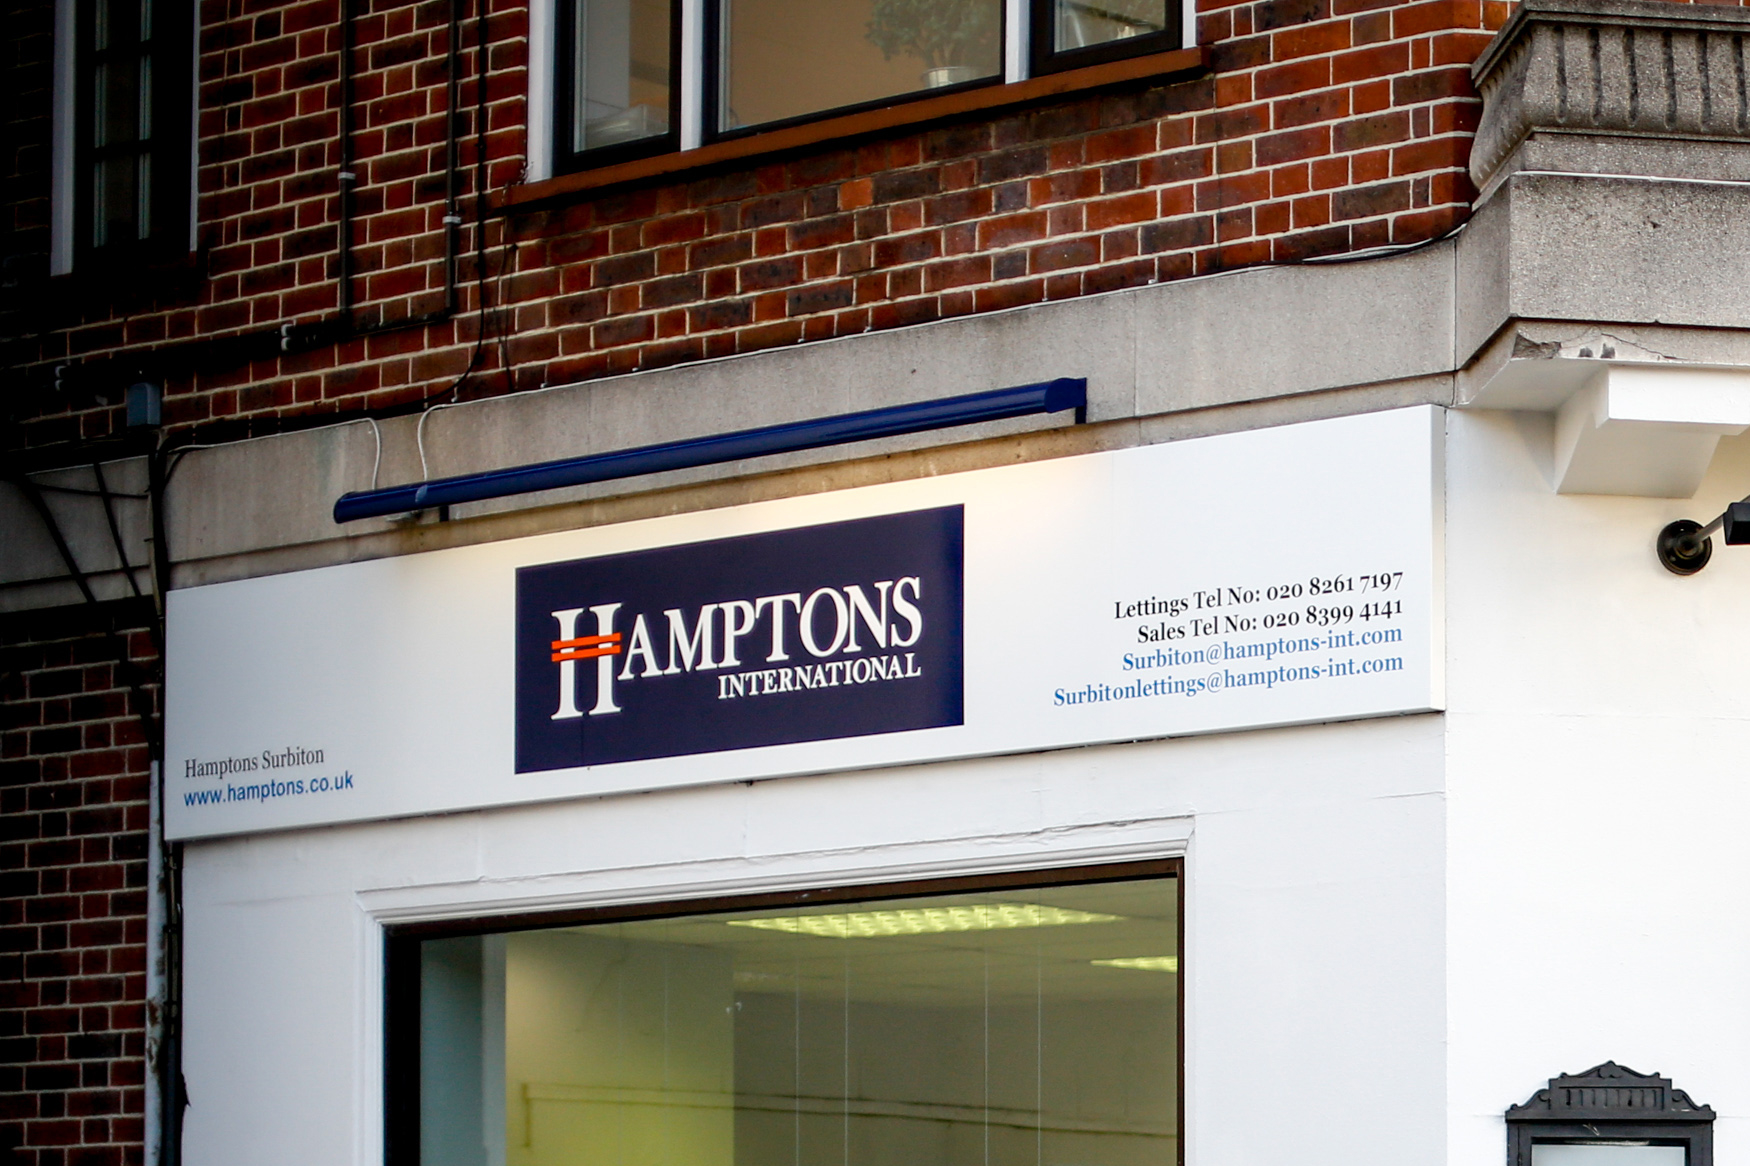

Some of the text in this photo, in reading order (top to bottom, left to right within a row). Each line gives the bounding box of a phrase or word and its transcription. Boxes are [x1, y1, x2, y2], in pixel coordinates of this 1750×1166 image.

[1114, 571, 1404, 620] Lettings Tel No: 020 8261 7197
[1137, 598, 1404, 645] Sales Tel No: 020 8399 4141
[550, 575, 923, 721] HAMPTONS
[1121, 627, 1403, 673] Surbiton@hamptons-int.com
[718, 652, 922, 701] INTERNATIONAL
[1053, 655, 1404, 708] Surbitonlettings@hamptons-int.com
[184, 745, 325, 780] Hamptons Surbiton
[183, 772, 354, 808] www.hamptons.co.uk
